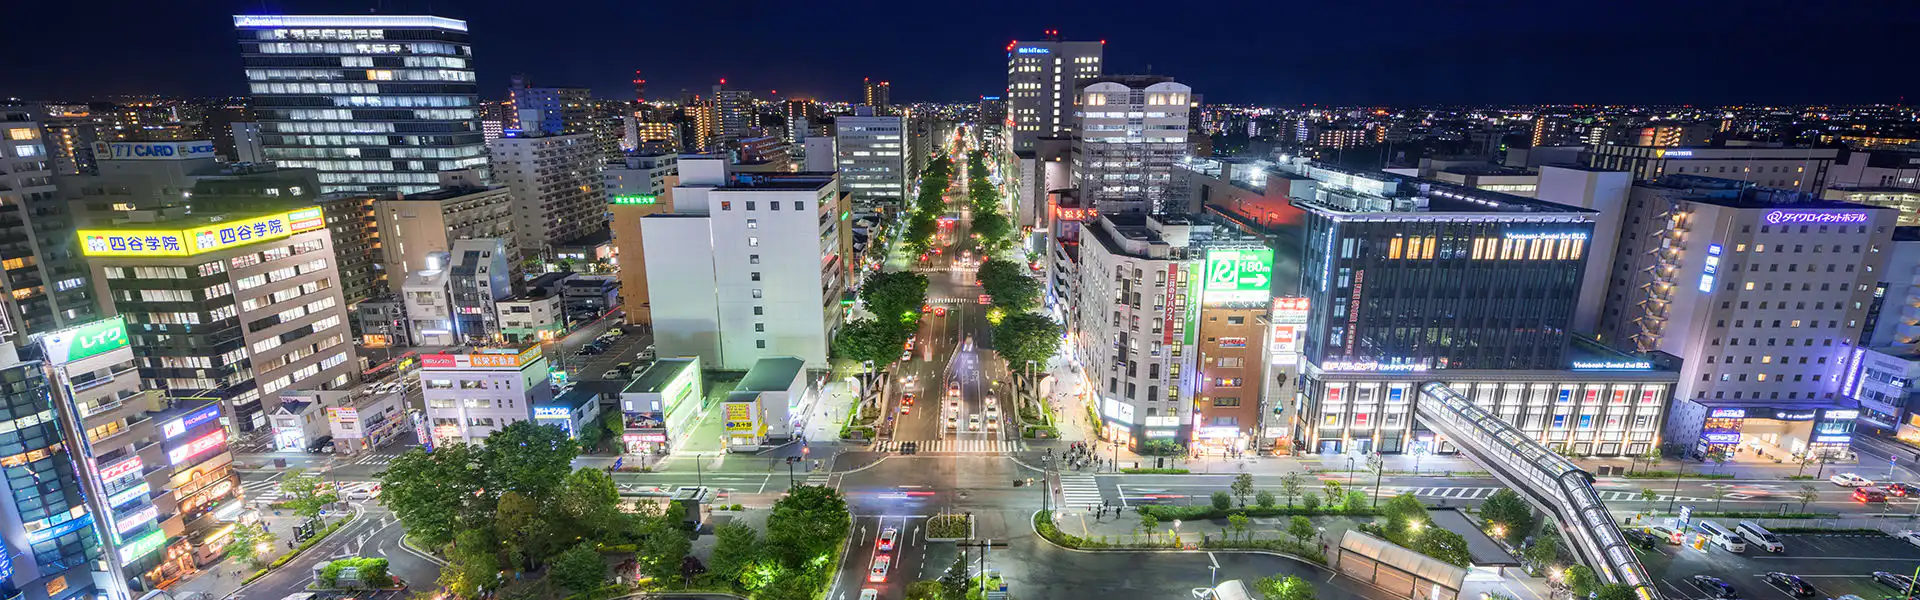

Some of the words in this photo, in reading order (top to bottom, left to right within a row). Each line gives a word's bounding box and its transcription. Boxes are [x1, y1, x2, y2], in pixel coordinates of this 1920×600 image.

[134, 144, 175, 157] CARD
[1782, 212, 1867, 223] ダイワロイネットホテル
[219, 218, 284, 245] 四谷学院
[109, 235, 181, 252] 四谷学院
[79, 326, 122, 349] レイク
